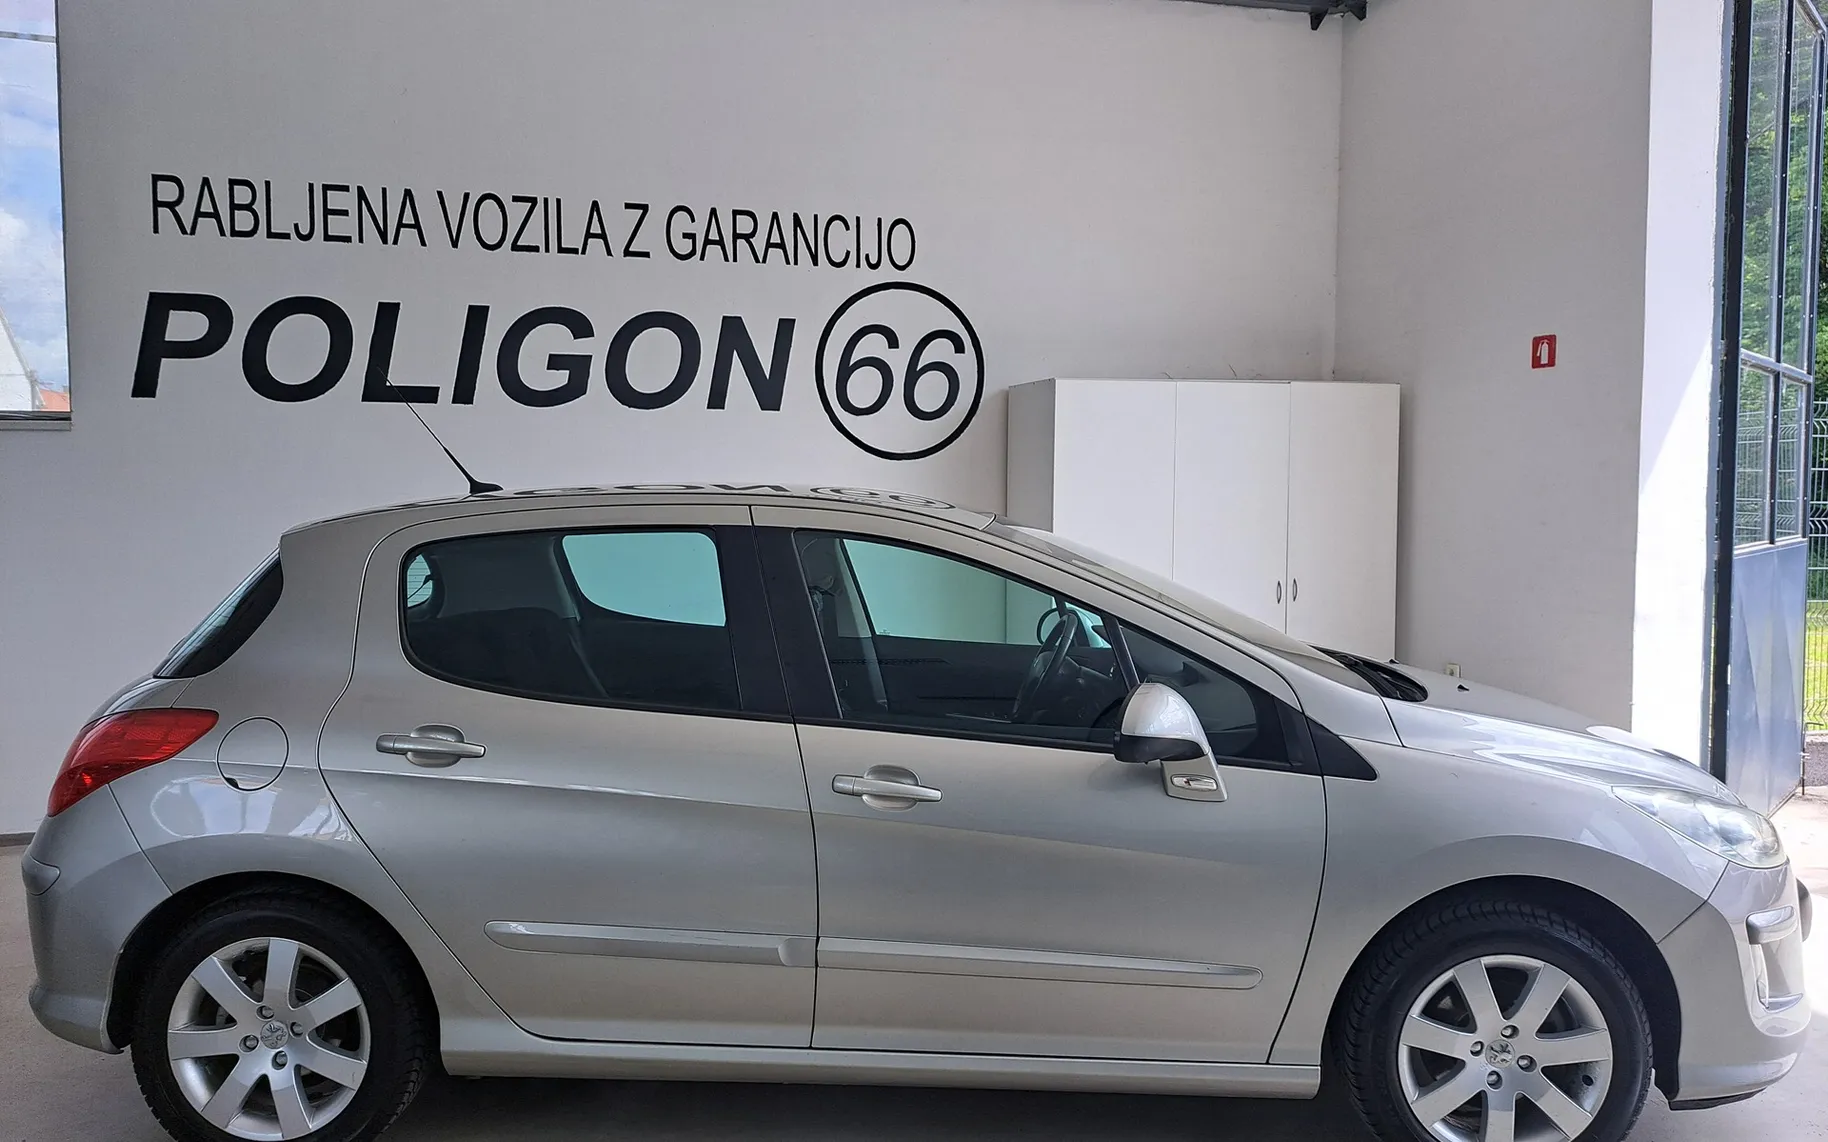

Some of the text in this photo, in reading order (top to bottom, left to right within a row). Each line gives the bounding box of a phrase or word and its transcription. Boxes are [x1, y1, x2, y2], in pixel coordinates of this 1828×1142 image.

[150, 173, 916, 272] RABLJENA VOZILA Z GARANCIJO
[130, 291, 966, 422] POLIGON 66
